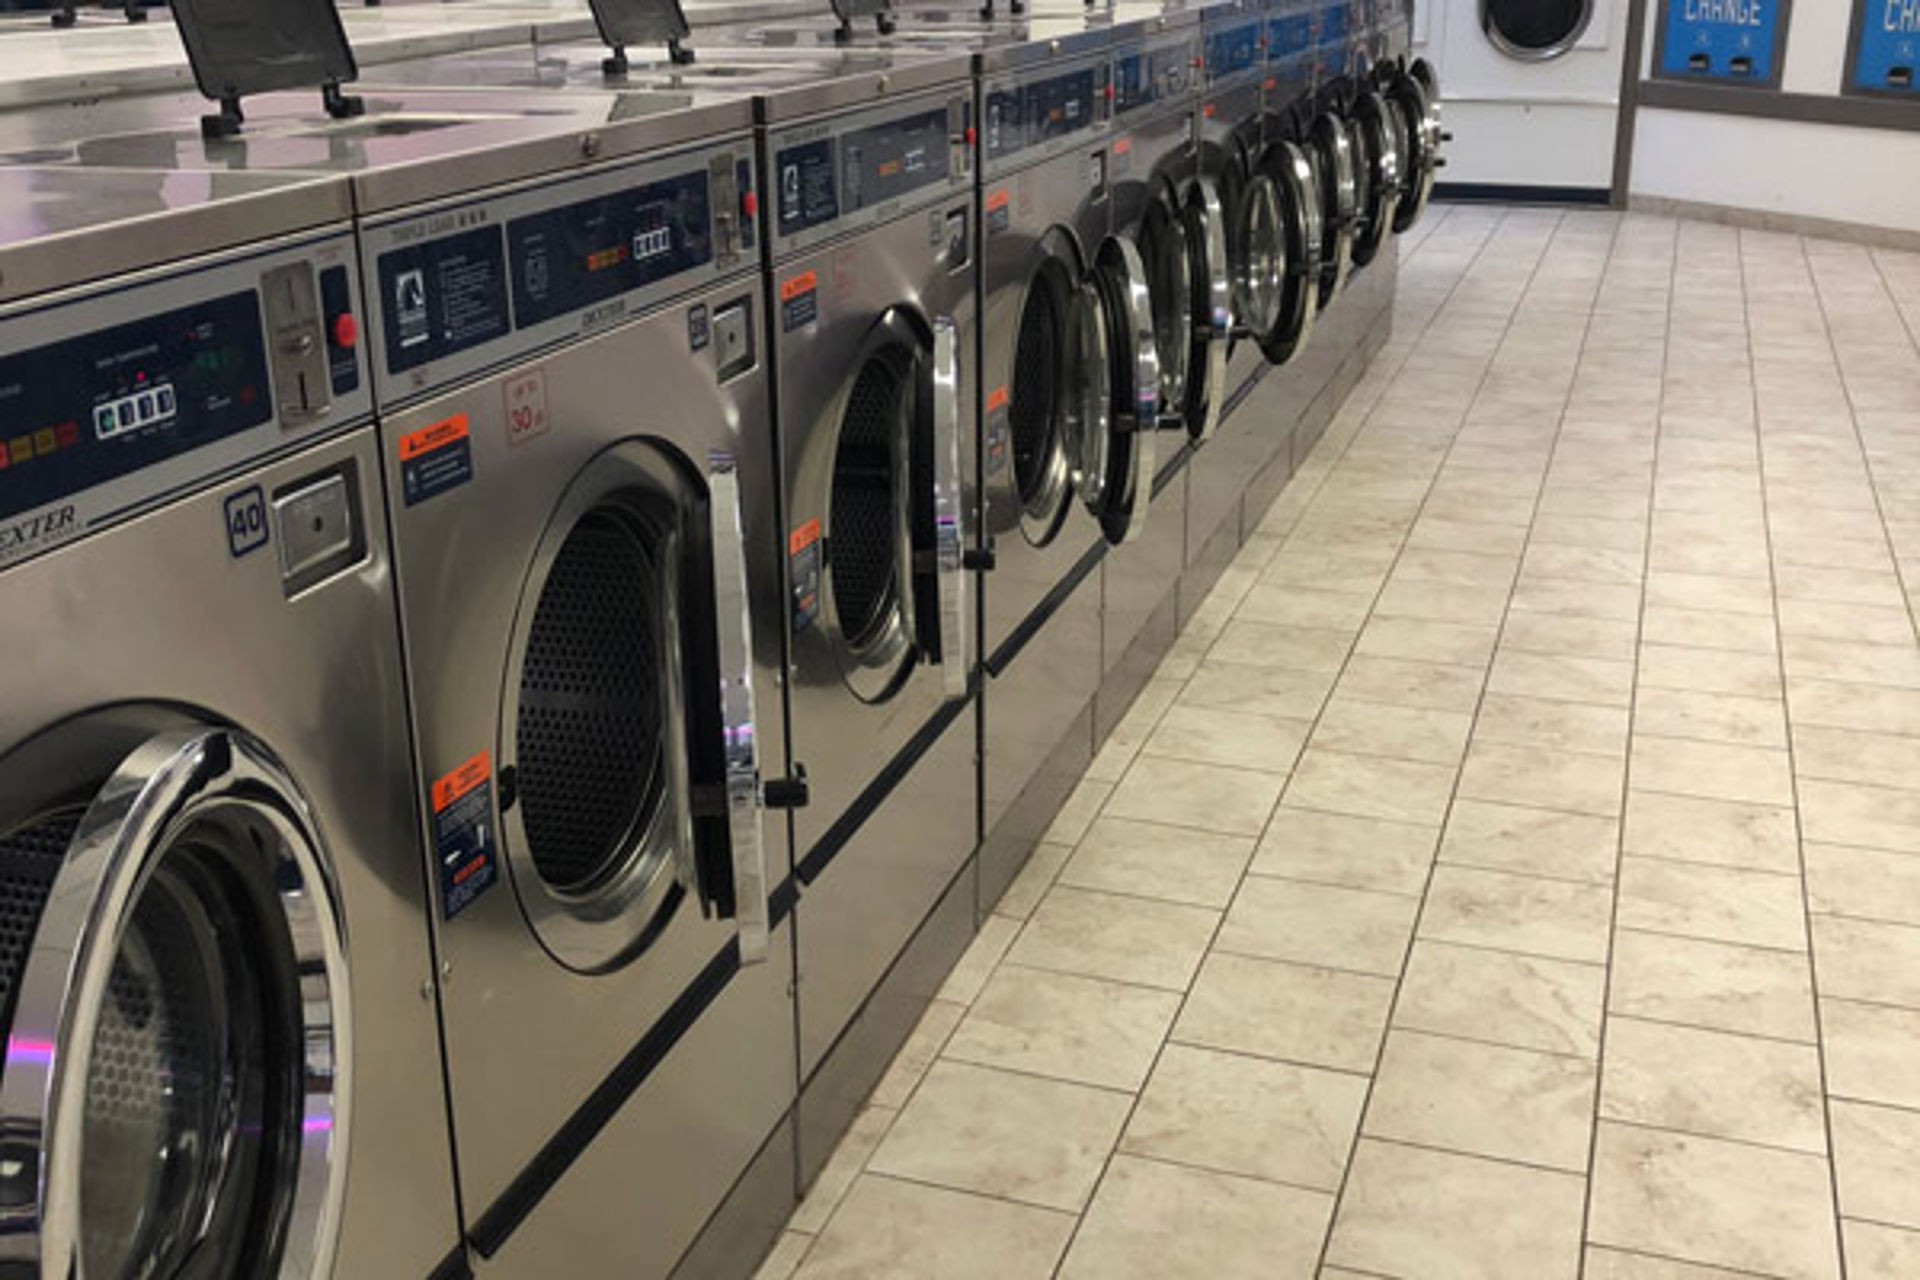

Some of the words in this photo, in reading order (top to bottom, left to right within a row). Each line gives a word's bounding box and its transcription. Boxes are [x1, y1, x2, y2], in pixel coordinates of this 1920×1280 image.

[1685, 0, 1761, 26] CHANGE
[512, 405, 532, 432] 30
[233, 503, 260, 538] 40
